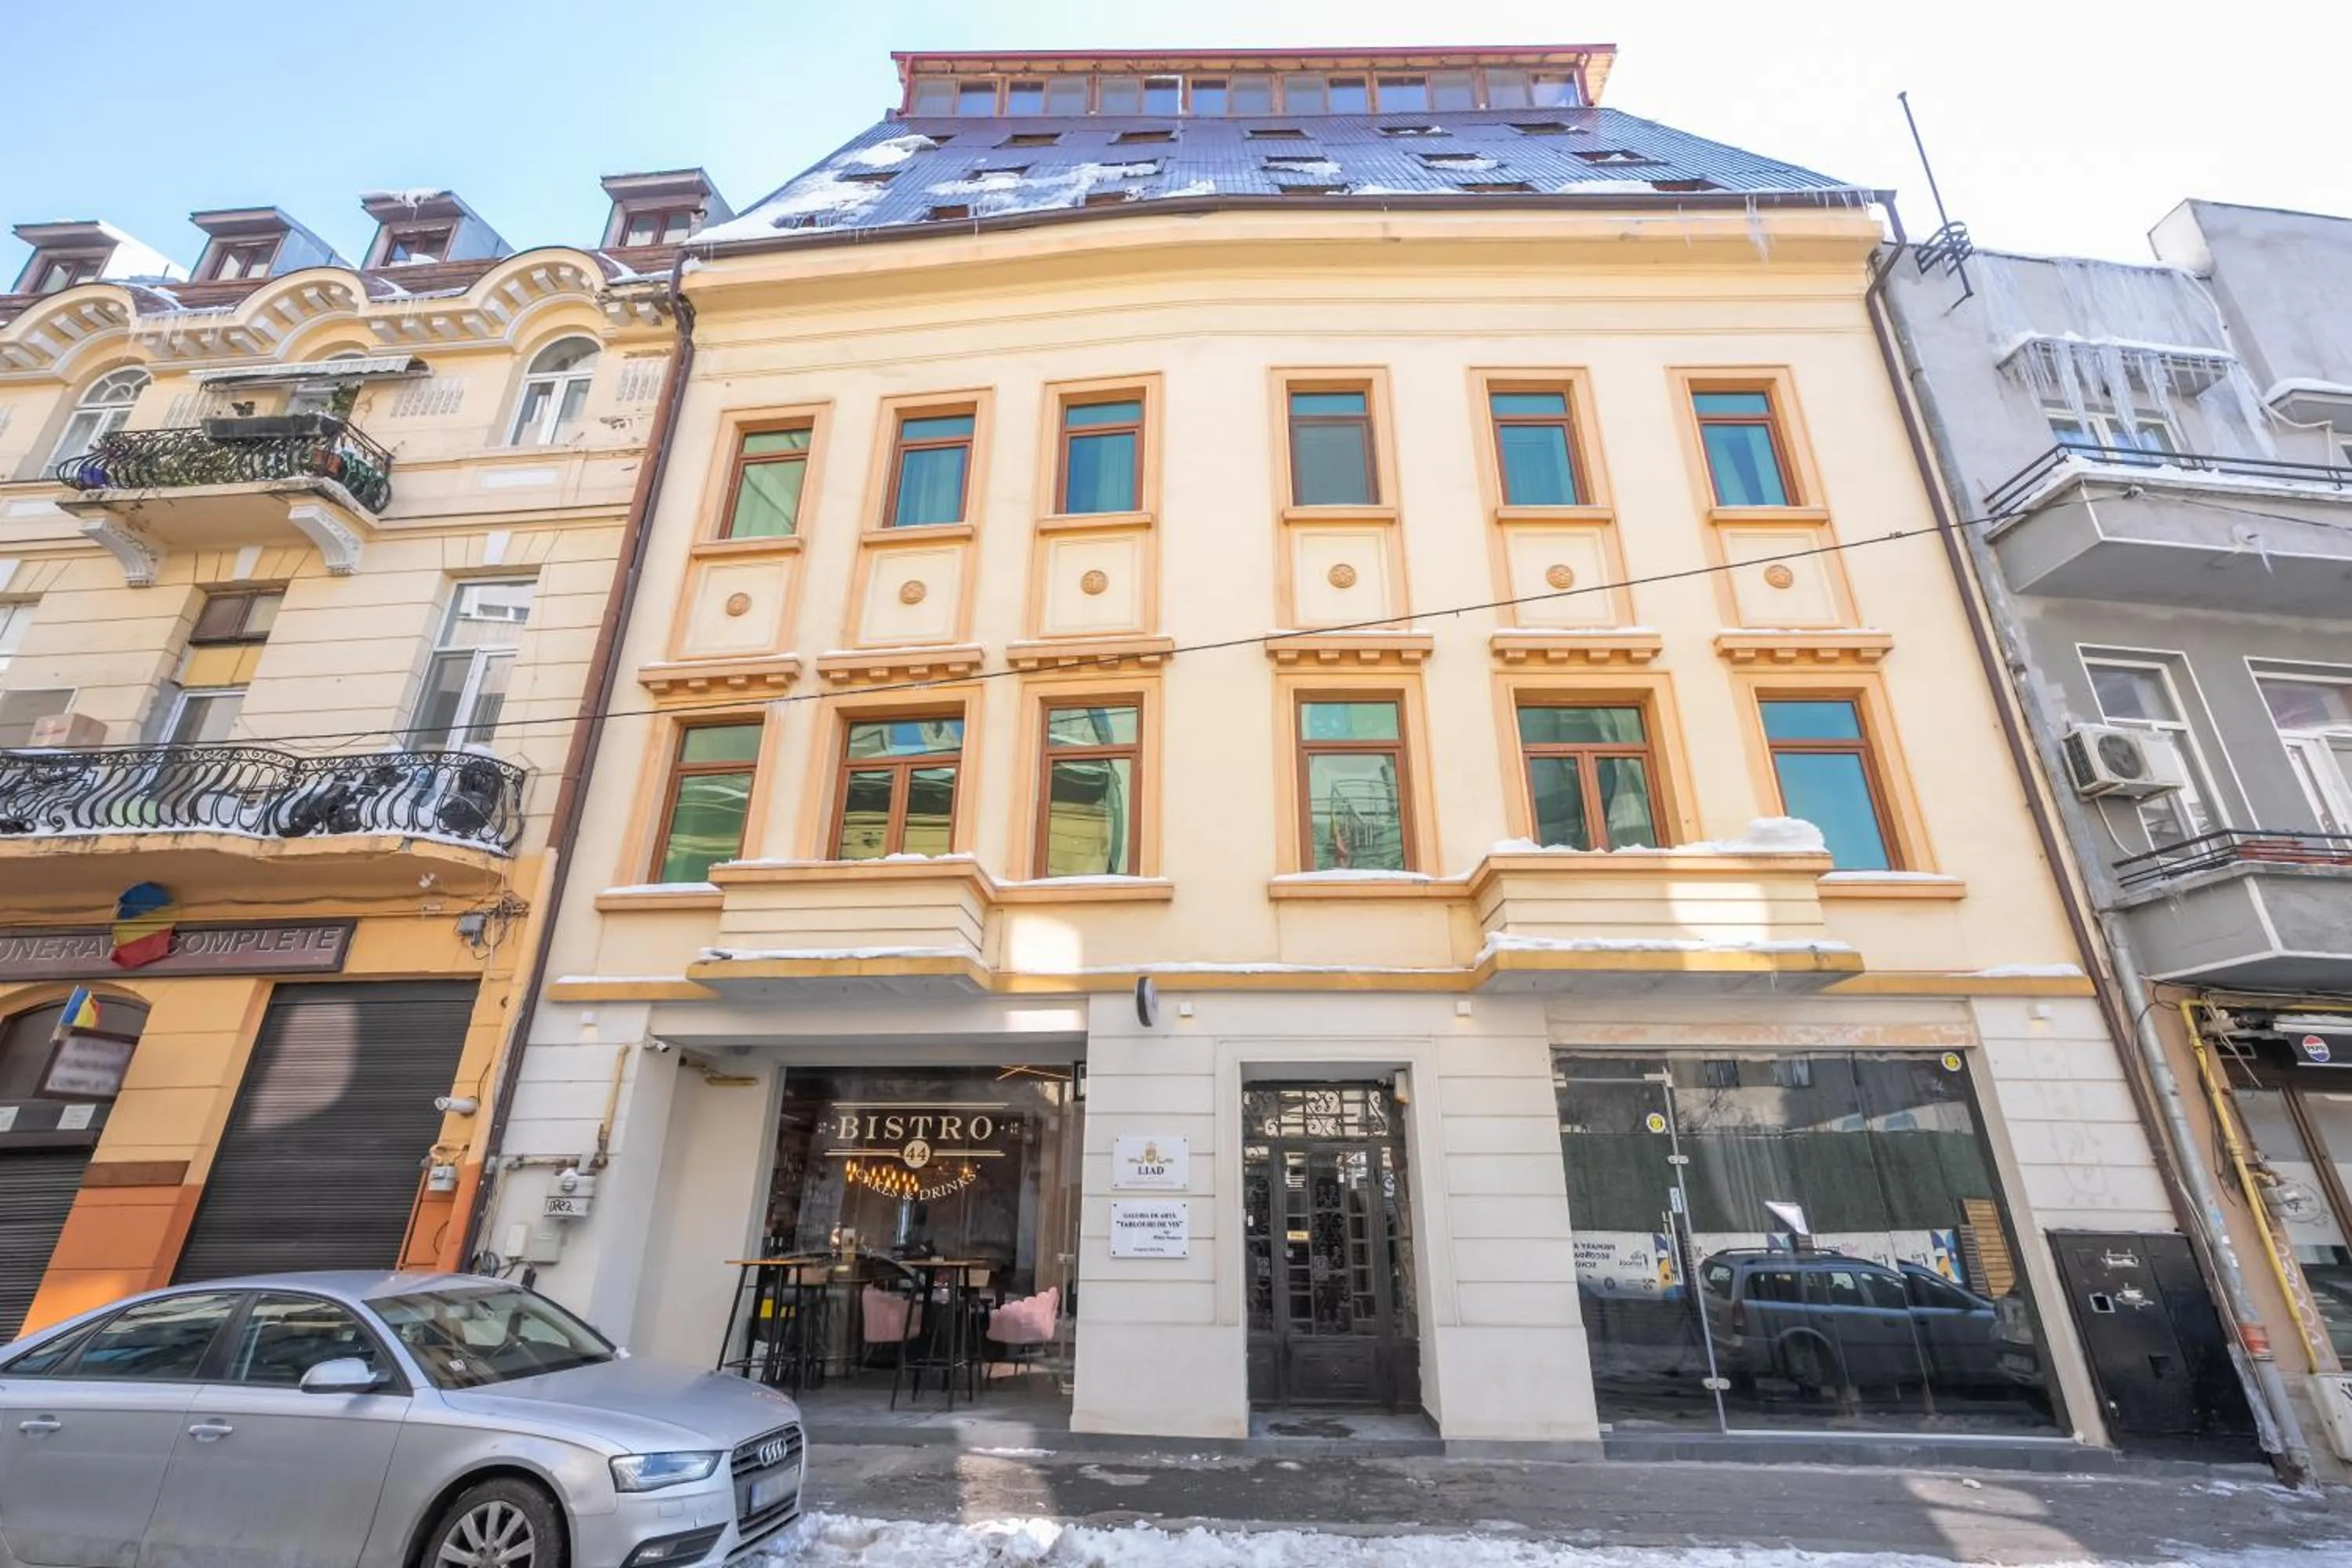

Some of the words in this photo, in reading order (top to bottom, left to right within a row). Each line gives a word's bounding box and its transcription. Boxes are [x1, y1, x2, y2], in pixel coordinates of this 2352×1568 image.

[837, 1116, 993, 1140] BISTRO
[906, 1147, 927, 1161] 44
[856, 1169, 898, 1198] CAKES
[902, 1192, 913, 1200] &
[920, 1173, 976, 1200] DRINKS
